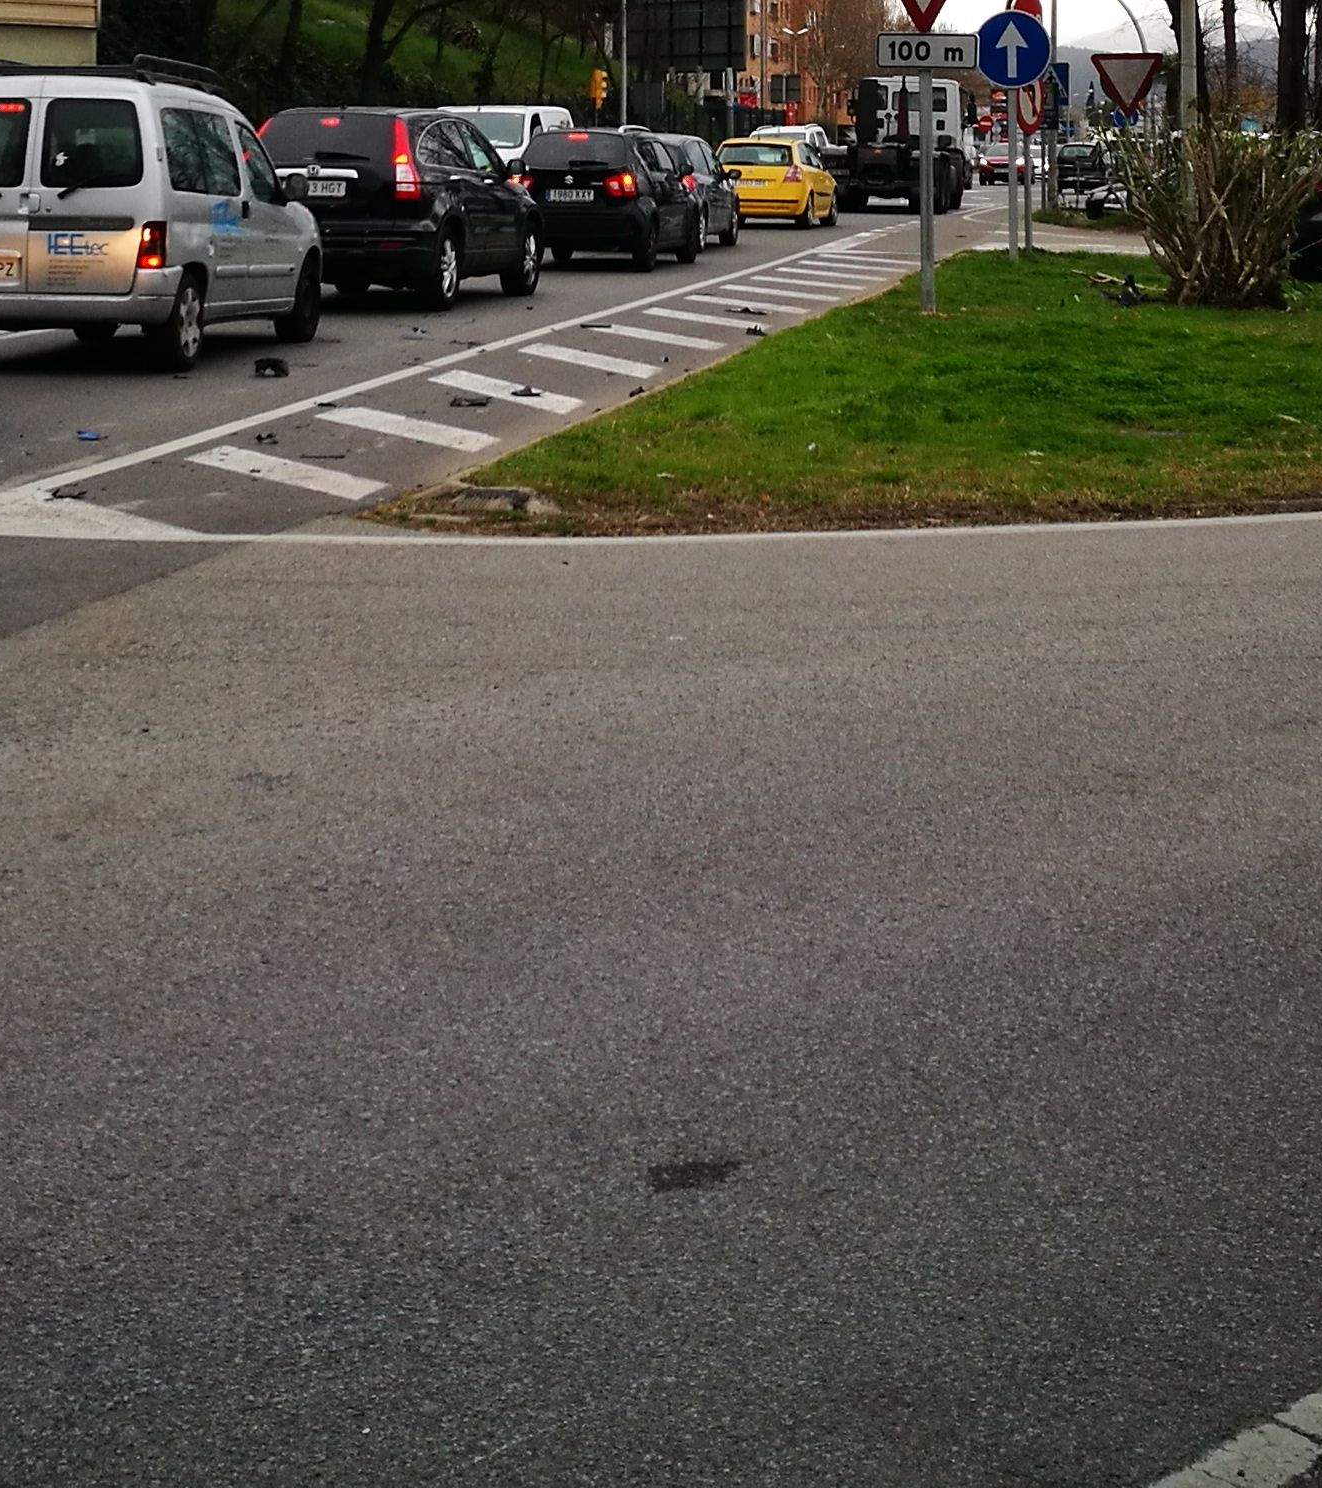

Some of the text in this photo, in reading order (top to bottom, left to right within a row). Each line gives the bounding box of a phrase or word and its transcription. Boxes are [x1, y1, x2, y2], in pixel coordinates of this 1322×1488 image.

[888, 40, 964, 62] 100 m
[321, 182, 343, 194] HGT
